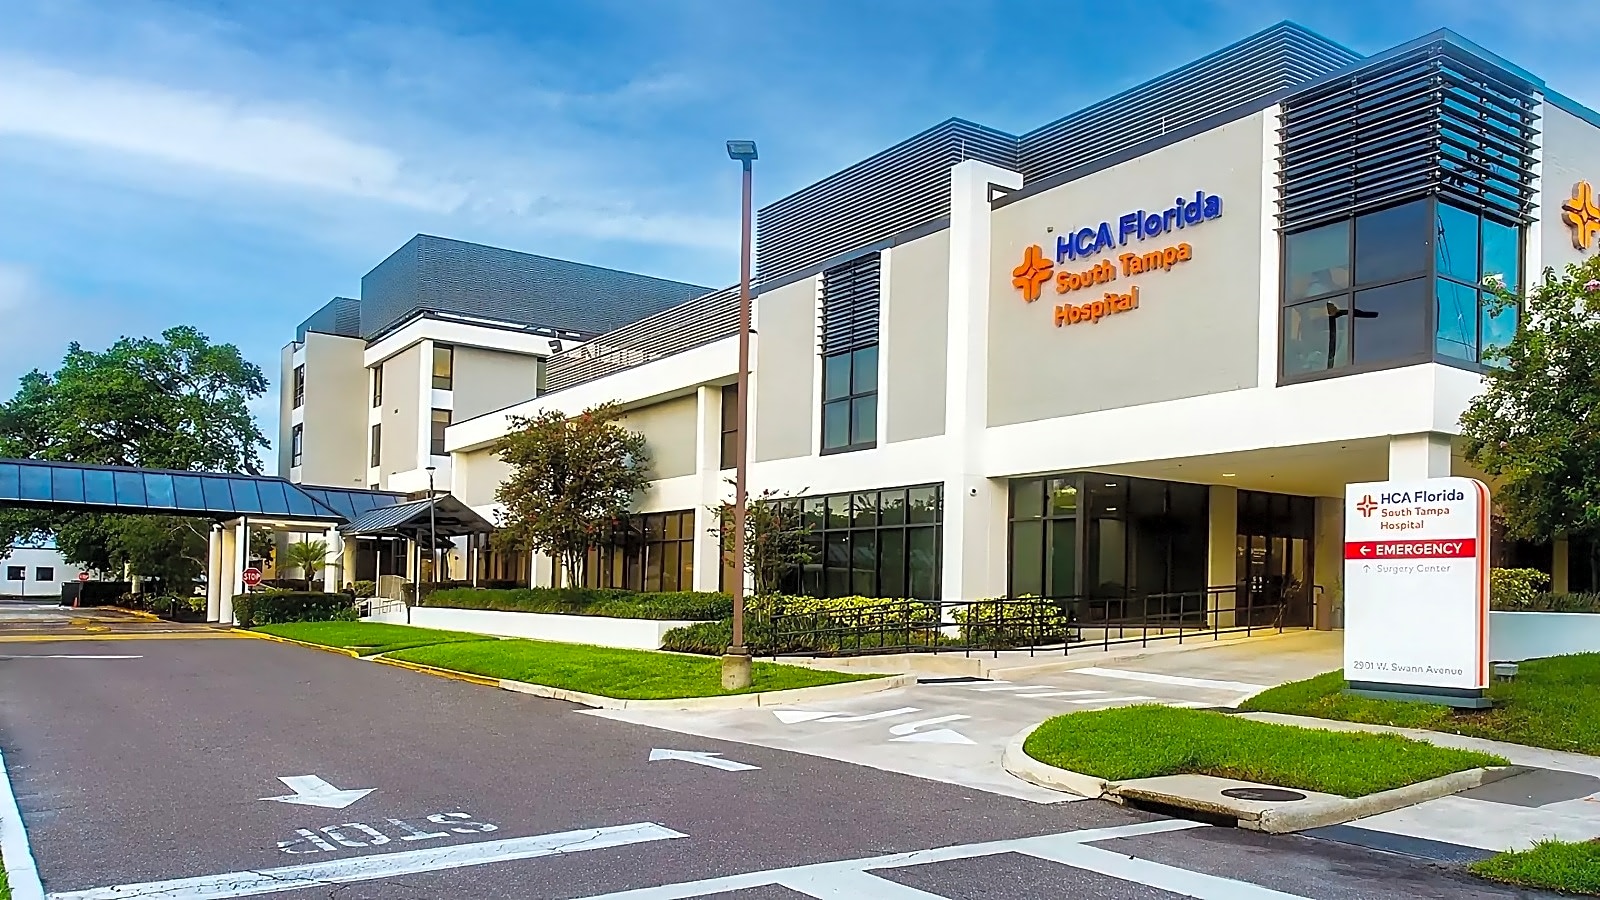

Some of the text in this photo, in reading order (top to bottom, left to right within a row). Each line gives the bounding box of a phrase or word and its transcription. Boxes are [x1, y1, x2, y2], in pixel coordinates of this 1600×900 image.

[1056, 190, 1222, 264] HCA Florida
[1056, 242, 1193, 294] South Tampa
[1054, 286, 1140, 327] Hospital
[1381, 489, 1464, 505] HCA Florida
[1381, 506, 1450, 518] South Tampa
[1380, 520, 1424, 531] Hospital
[1375, 542, 1463, 556] EMERGENCY
[243, 572, 261, 581] STOP
[1377, 564, 1451, 575] Surgery Center
[1353, 661, 1463, 676] 2901 W. Swann Avenue
[277, 811, 499, 854] STOP
